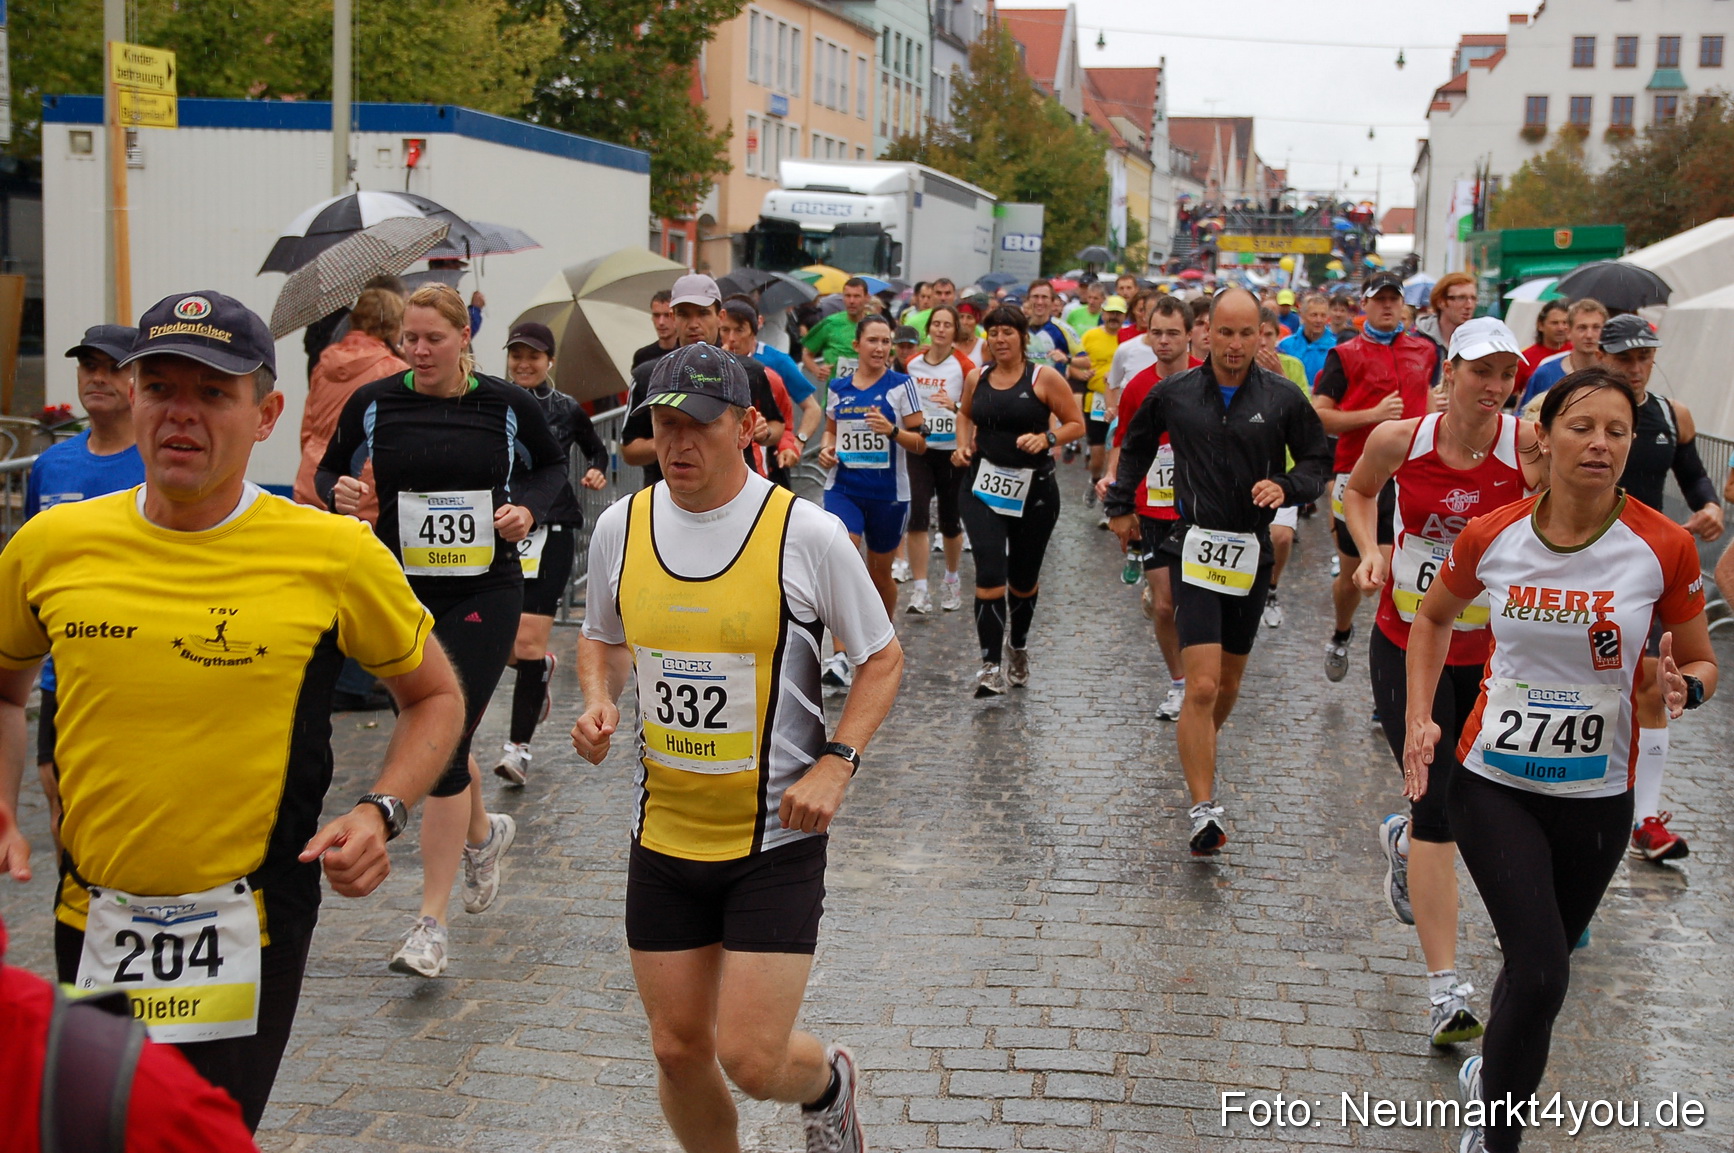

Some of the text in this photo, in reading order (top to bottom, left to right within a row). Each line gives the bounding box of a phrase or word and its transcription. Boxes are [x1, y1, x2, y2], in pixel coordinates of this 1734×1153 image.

[791, 202, 852, 216] BOCK
[1252, 240, 1292, 249] START
[917, 378, 947, 387] MERZ
[842, 433, 884, 451] 3155
[980, 473, 1025, 498] 3357
[427, 497, 464, 505] BOCK
[419, 514, 475, 544] 439
[1421, 513, 1470, 541] AS
[428, 552, 466, 564] Stefan
[1198, 540, 1245, 569] 347
[1206, 570, 1226, 584] Jörg
[1508, 585, 1615, 613] MERZ
[208, 607, 238, 616] TSV
[1501, 599, 1590, 625] Reisen
[65, 621, 138, 638] Dieter
[180, 649, 253, 667] Burgthann
[662, 658, 712, 672] BOCK
[1527, 689, 1580, 702] BOCK
[655, 681, 728, 729] 332
[1495, 710, 1605, 754] 2749
[666, 734, 716, 757] Hubert
[1525, 762, 1566, 778] Ilona
[113, 925, 224, 983] 204
[131, 996, 201, 1019] Dieter
